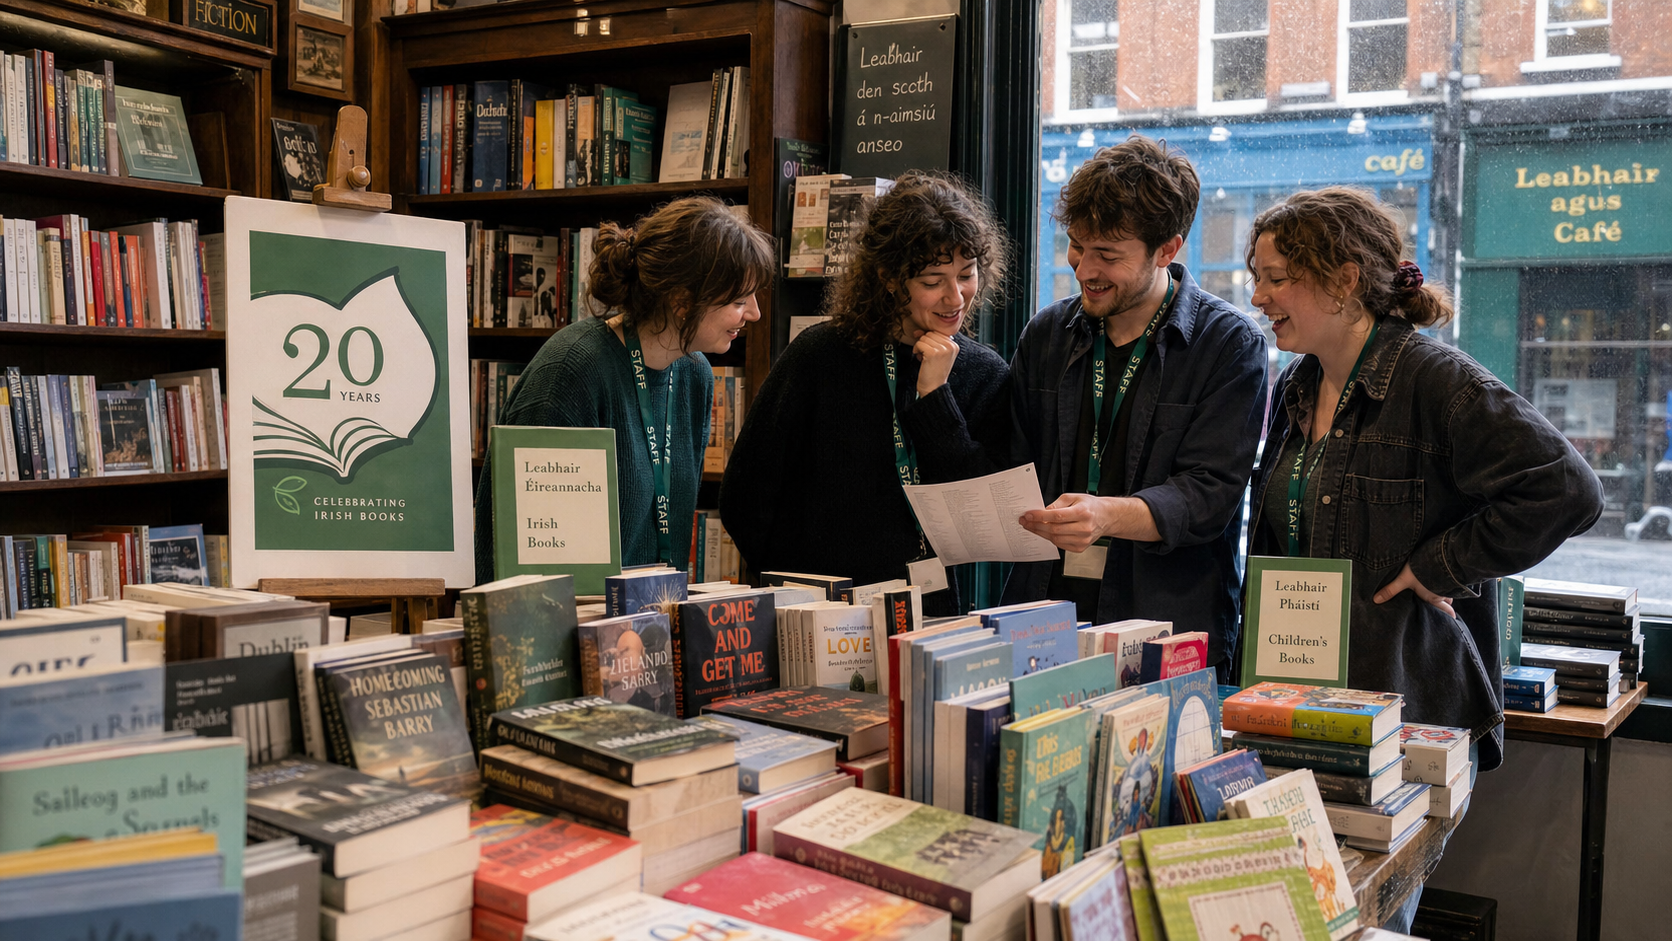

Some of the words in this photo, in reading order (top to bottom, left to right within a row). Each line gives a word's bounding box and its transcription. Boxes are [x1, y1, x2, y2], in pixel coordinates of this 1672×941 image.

[856, 79, 882, 99] den
[856, 108, 866, 126] á
[873, 103, 936, 125] n-aimsiú
[856, 138, 903, 154] anseo
[1364, 148, 1425, 177] café
[1514, 162, 1660, 189] Leabhair
[1550, 193, 1622, 216] agus
[1553, 220, 1622, 244] Café
[282, 323, 385, 400] 20
[630, 349, 647, 390] STAFF
[883, 343, 896, 381] STAFF
[1119, 355, 1141, 394] STAFF
[1095, 360, 1104, 398] STAFF
[340, 391, 381, 403] YEARS
[646, 426, 660, 466] STAFF
[524, 461, 581, 474] Leabhair
[525, 478, 602, 493] Éireannacha
[314, 511, 352, 521] IRISH
[360, 512, 405, 522] BOOKS
[526, 517, 559, 529] Irish
[657, 495, 669, 535] STAFF
[1289, 499, 1299, 541] STAFF
[527, 536, 566, 549] Books
[1275, 580, 1328, 593] Leabhair
[708, 599, 756, 626] COME
[1279, 598, 1321, 611] Pháistí
[715, 626, 752, 653] AND
[827, 637, 872, 655] LOVE
[1268, 633, 1328, 648] Children's
[702, 655, 736, 683] GET
[740, 651, 765, 676] ME
[1278, 652, 1315, 665] Books
[350, 664, 446, 698] HOMECOMING
[364, 690, 443, 721] SEBASTIAN
[384, 714, 434, 741] BARRY
[127, 774, 169, 803] and
[176, 772, 210, 796] the
